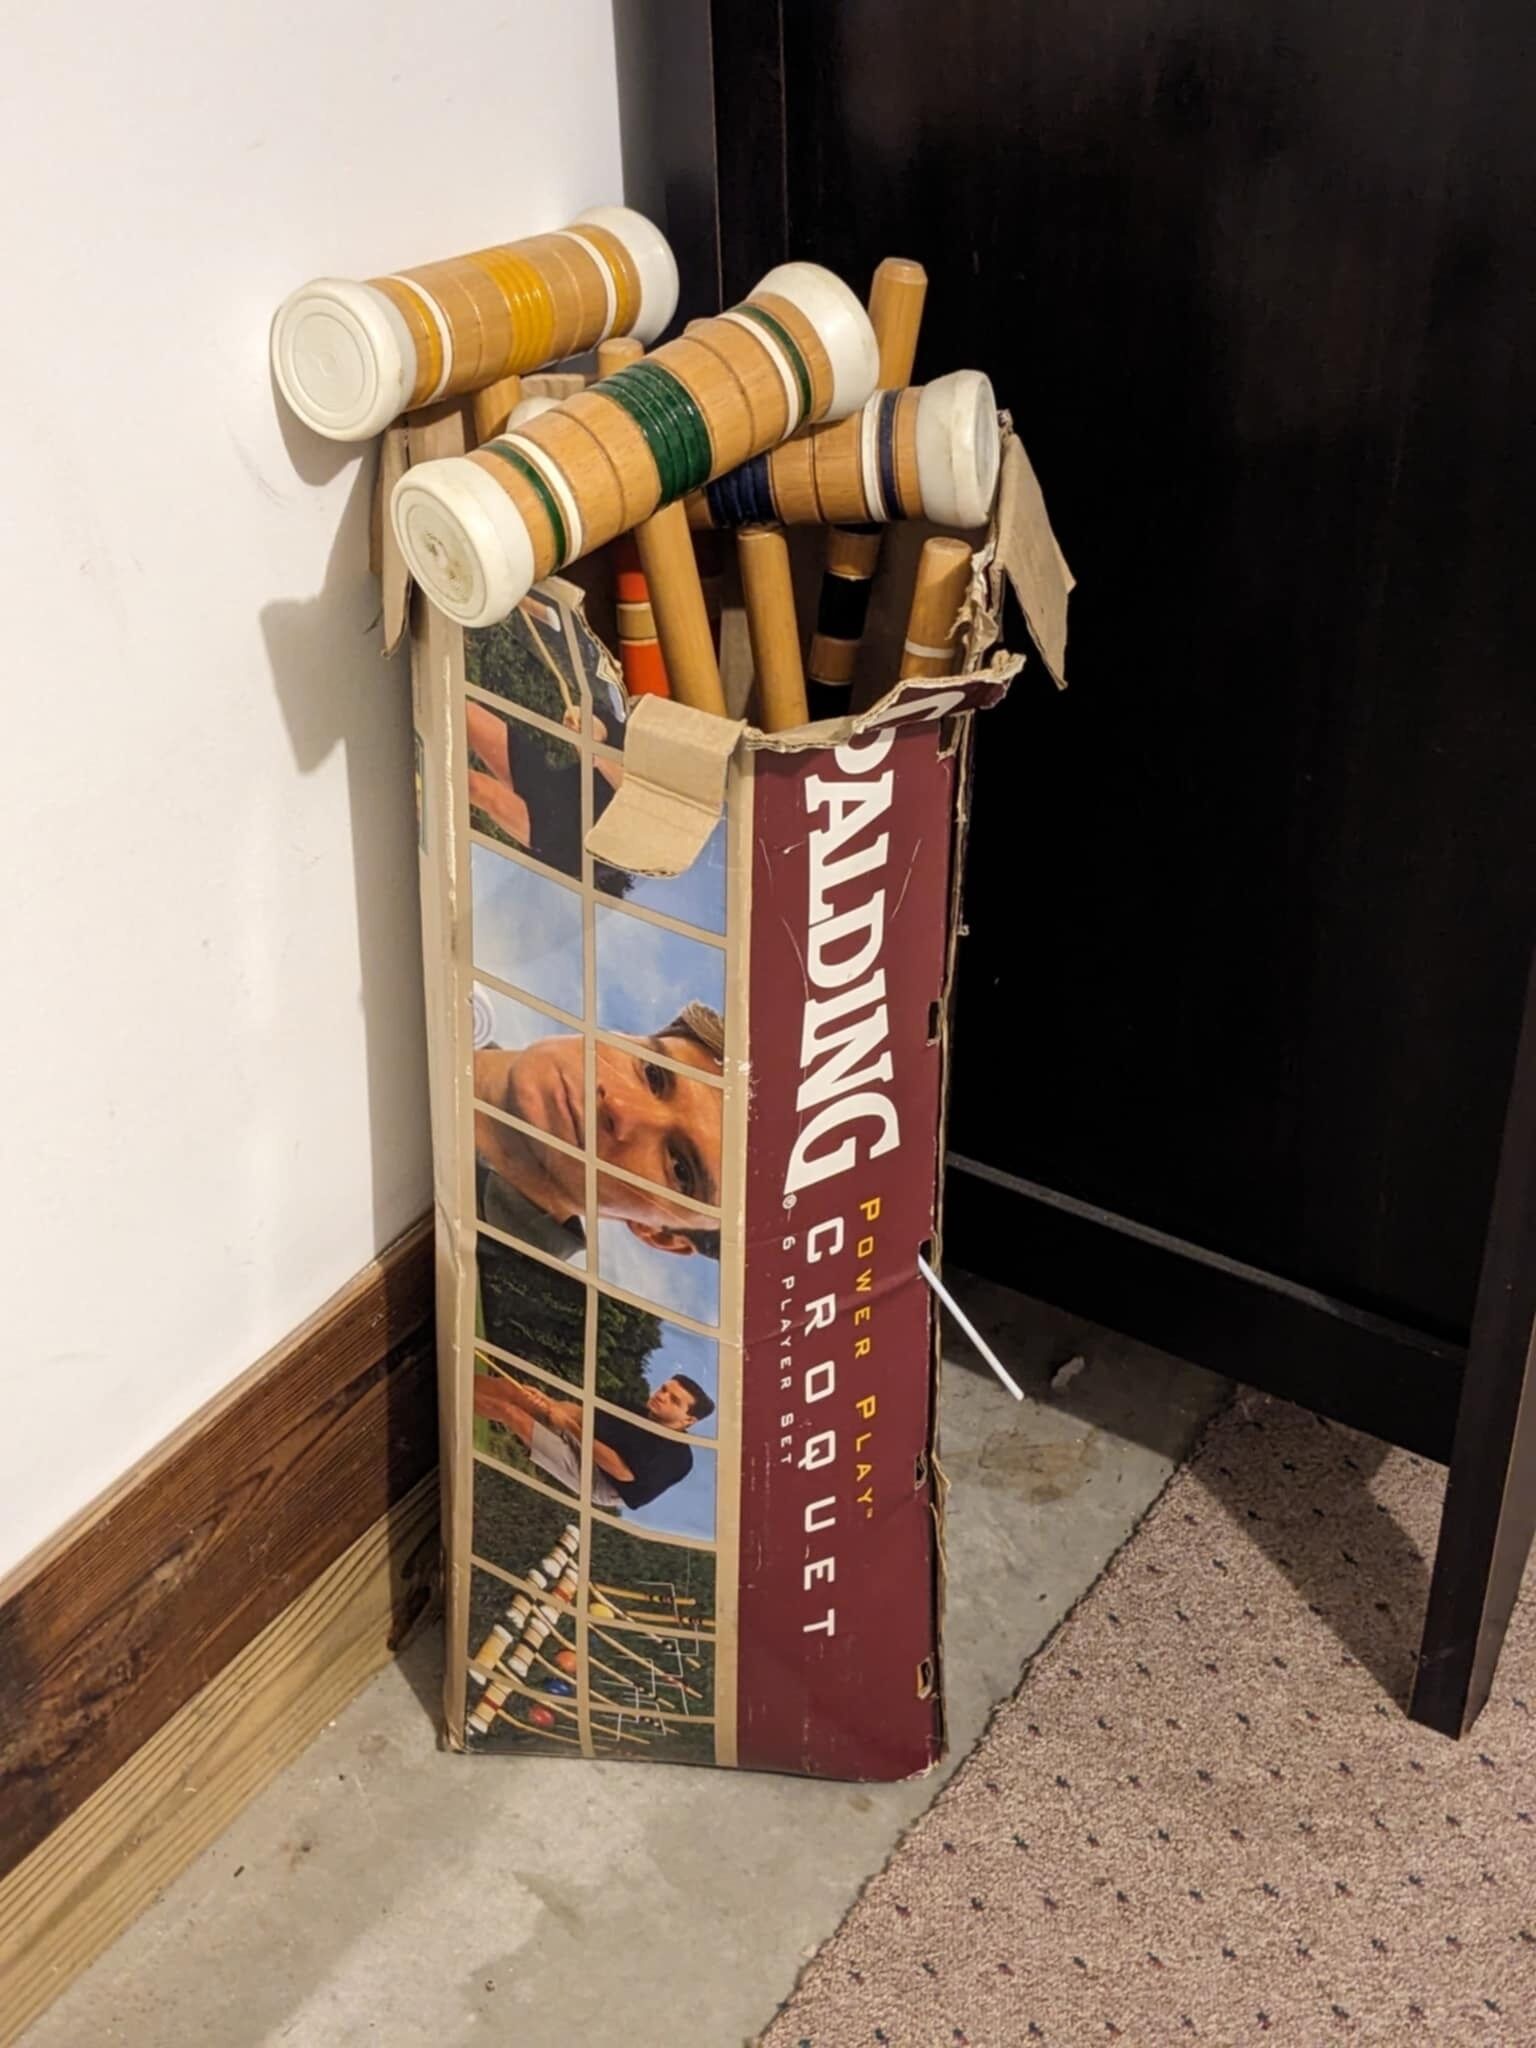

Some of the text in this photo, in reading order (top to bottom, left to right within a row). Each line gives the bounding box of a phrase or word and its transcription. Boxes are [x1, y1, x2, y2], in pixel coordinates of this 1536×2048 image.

[780, 1235, 796, 1464] 6 PLAYER SET
[797, 1216, 845, 1637] CROQUET
[854, 1197, 881, 1503] POWER PLAY
